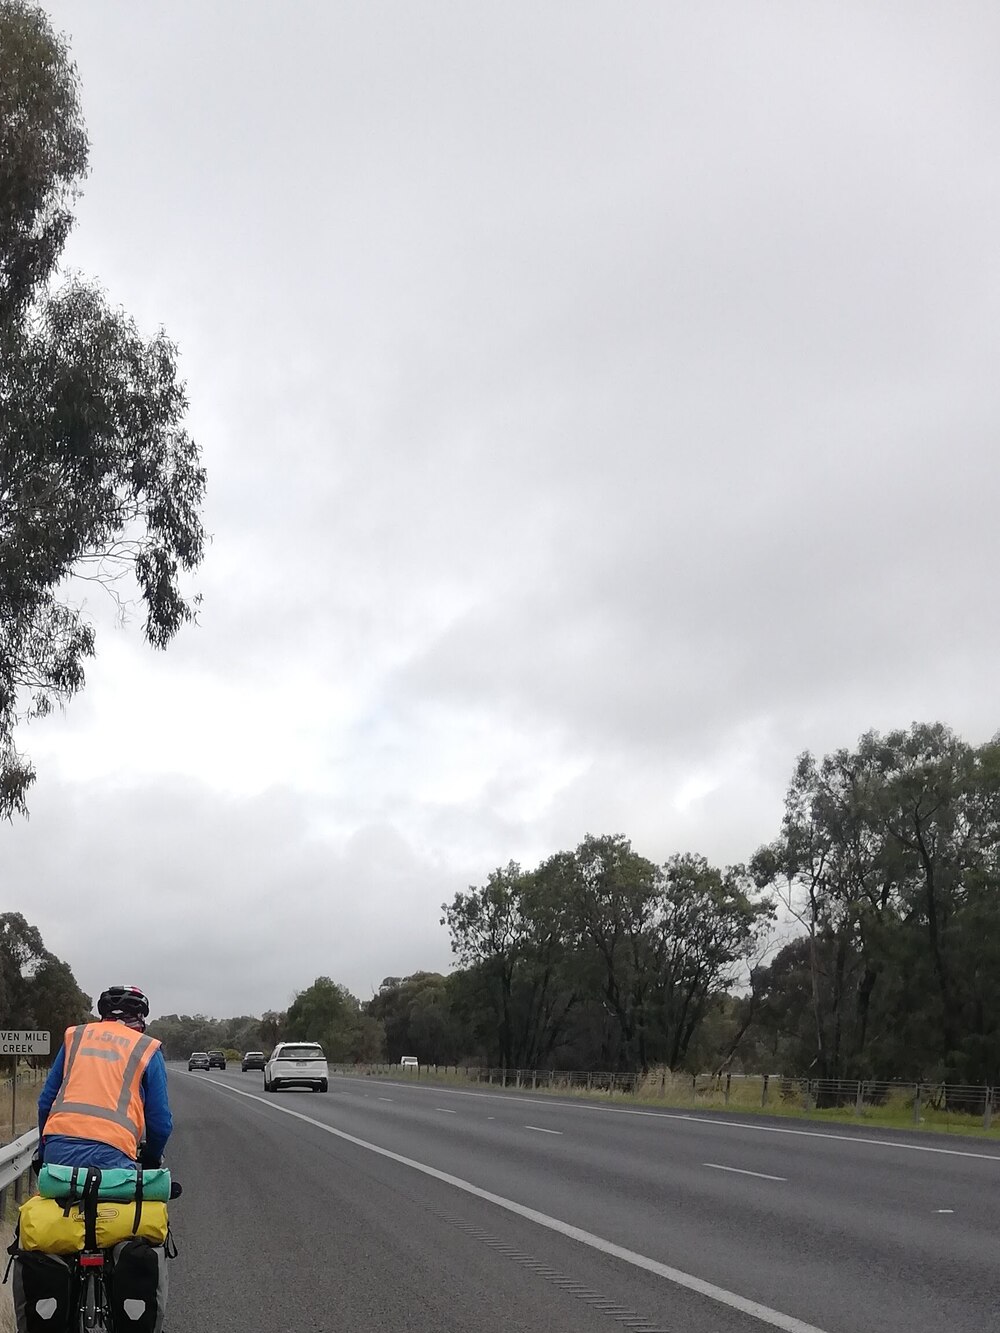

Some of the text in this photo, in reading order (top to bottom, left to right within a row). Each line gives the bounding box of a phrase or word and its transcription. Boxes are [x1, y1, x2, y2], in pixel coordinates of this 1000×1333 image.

[25, 1032, 48, 1041] MILE
[86, 1028, 131, 1049] 1.5m
[2, 1044, 34, 1053] CREEK
